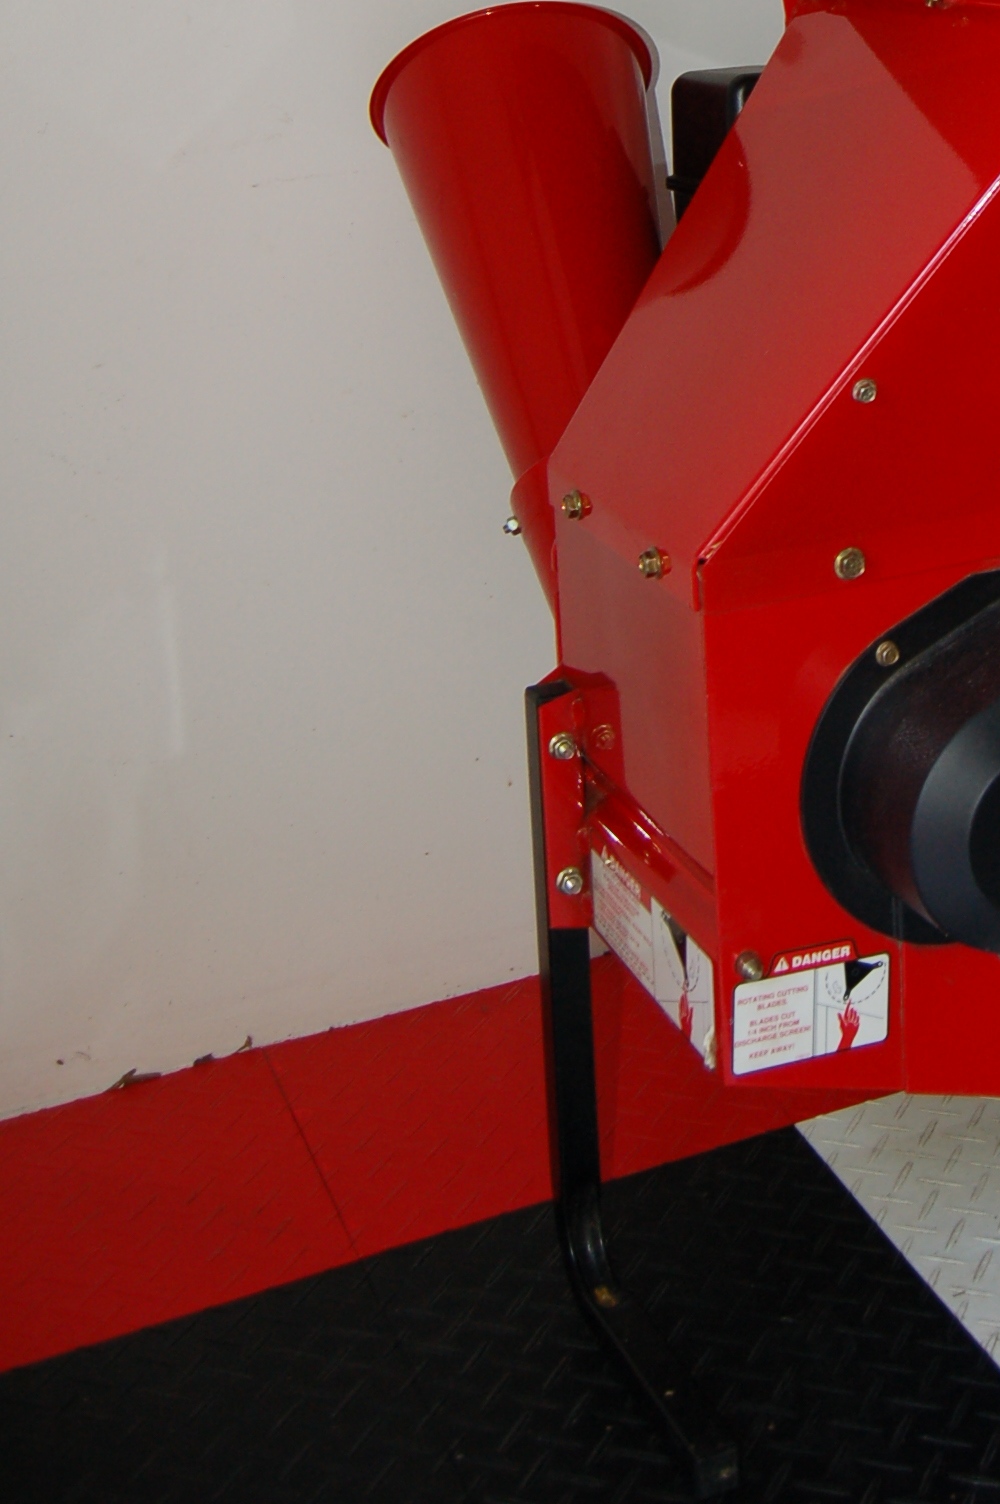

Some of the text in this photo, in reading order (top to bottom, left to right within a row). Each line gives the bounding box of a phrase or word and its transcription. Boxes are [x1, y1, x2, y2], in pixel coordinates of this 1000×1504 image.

[791, 945, 851, 968] DANGER
[737, 986, 809, 1005] ROTATING CUTTING
[749, 1011, 796, 1027] BLADES CUT
[778, 1019, 800, 1029] FROM
[748, 1049, 769, 1060] KEEP
